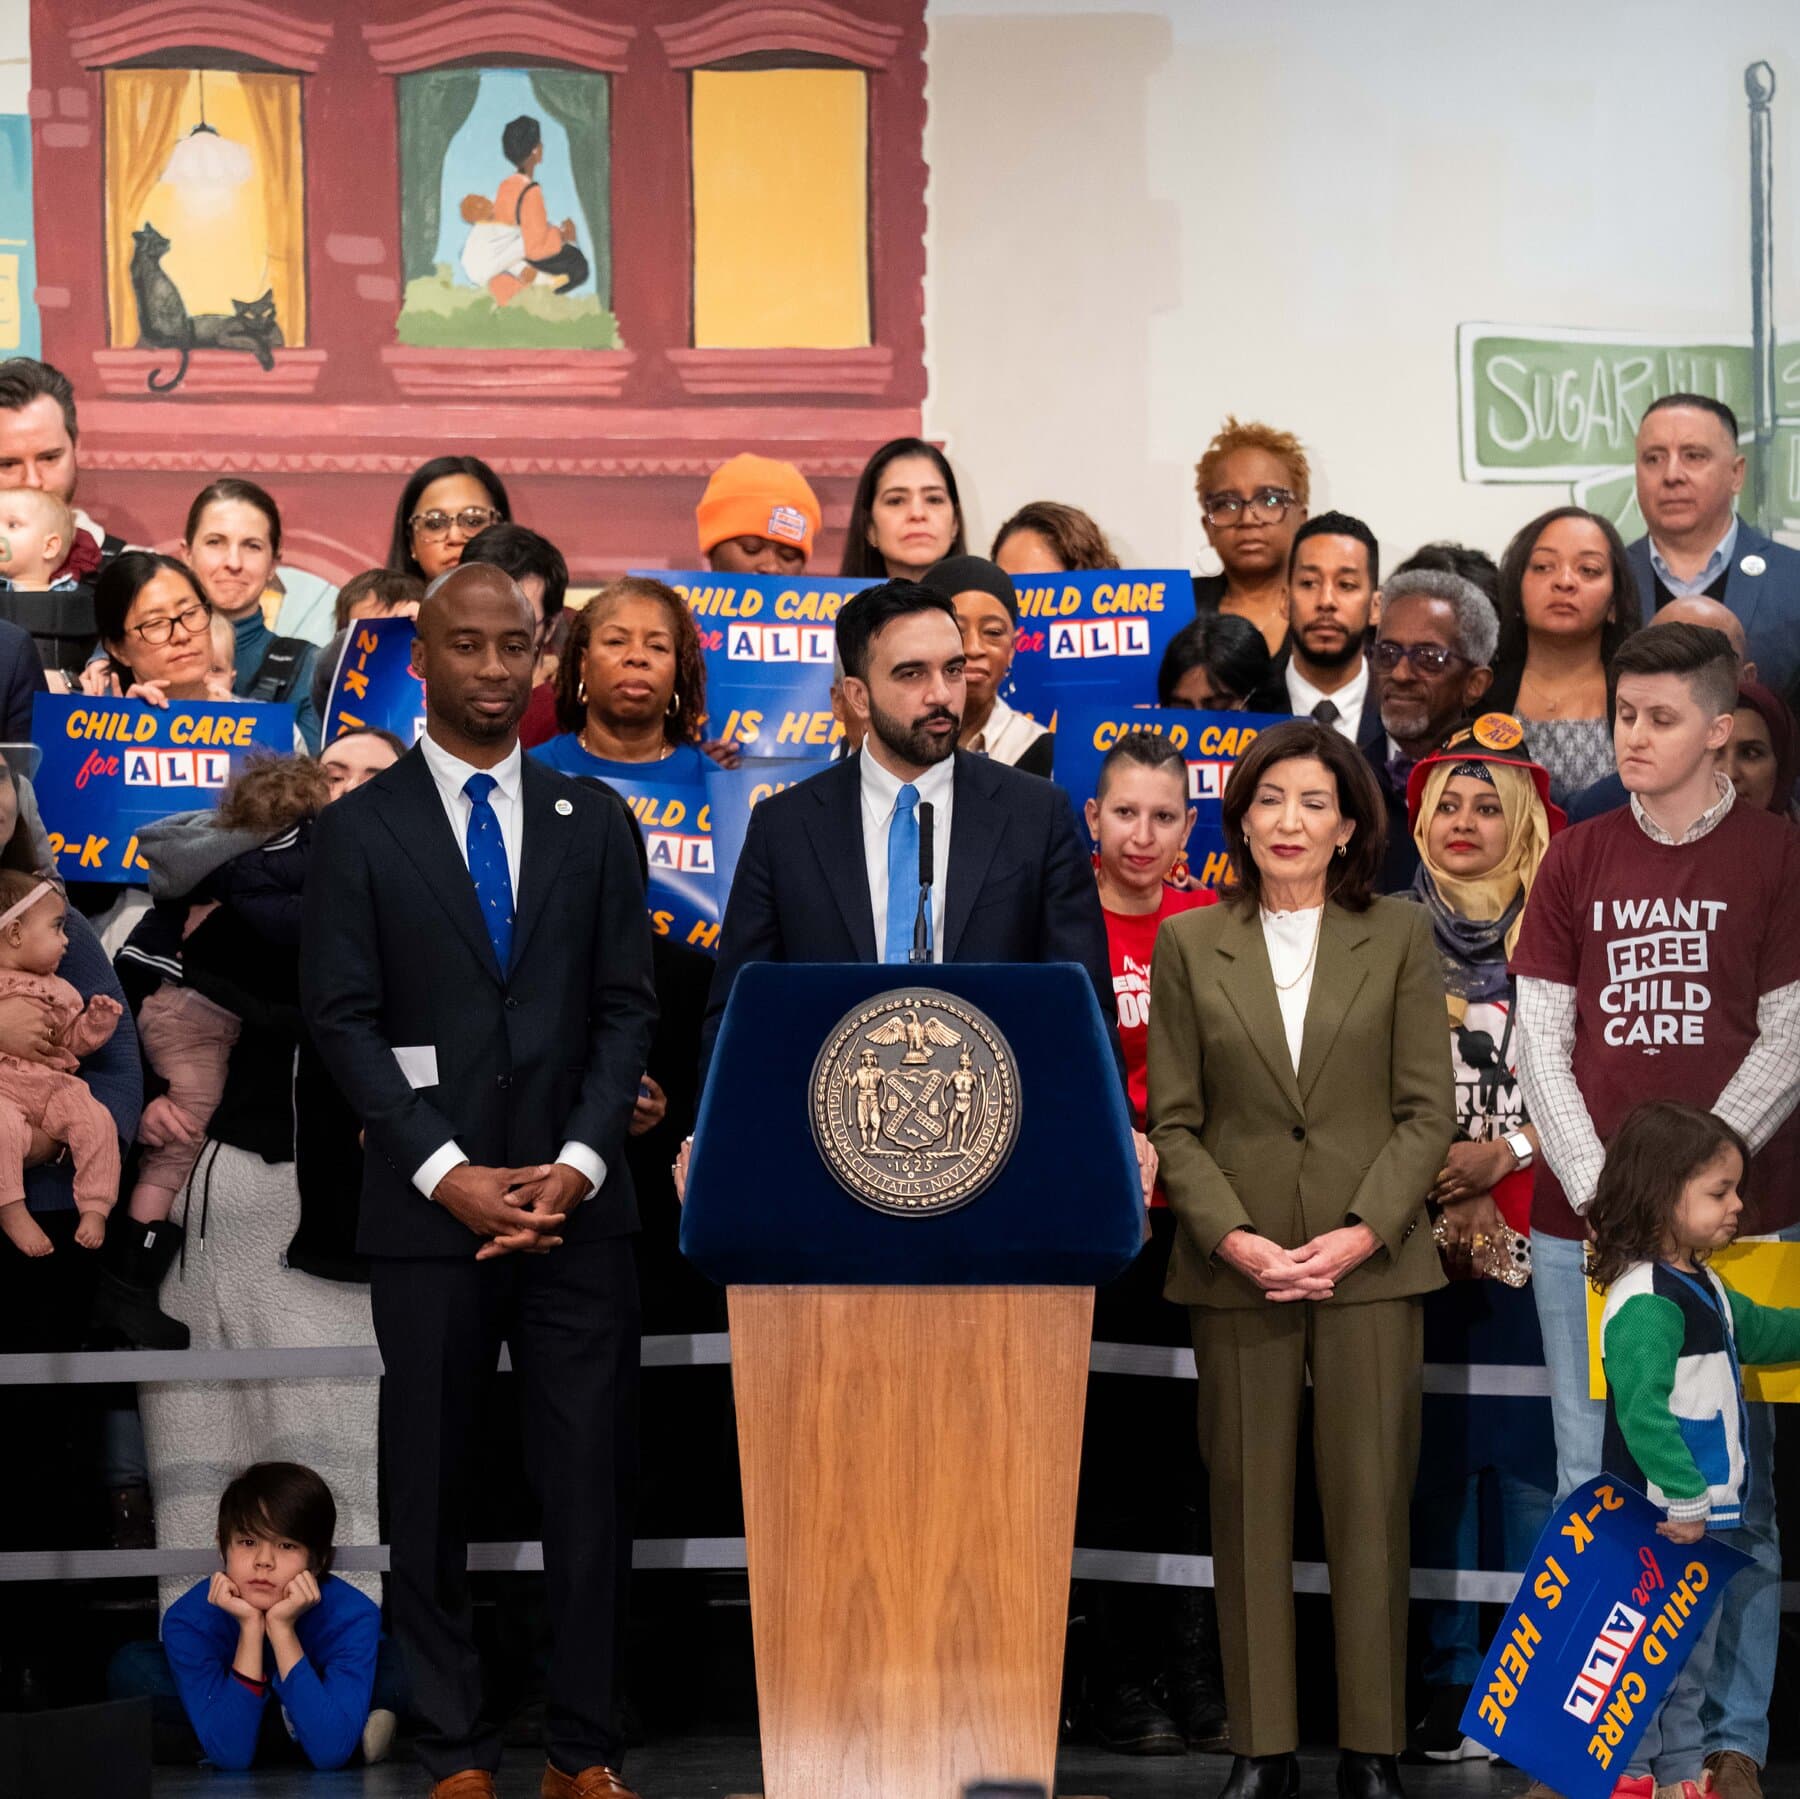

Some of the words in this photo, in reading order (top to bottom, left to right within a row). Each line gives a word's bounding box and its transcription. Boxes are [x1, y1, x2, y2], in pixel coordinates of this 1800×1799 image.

[1486, 354, 1651, 451] SUGAR
[1015, 585, 1082, 618] HILD
[1091, 582, 1166, 615] CARE
[699, 626, 723, 651] or
[732, 629, 829, 659] ALL
[1054, 626, 1145, 654] ALL
[344, 629, 379, 701] 2-K
[66, 709, 157, 743] CHILD
[169, 714, 257, 747] CARE
[721, 709, 764, 744] IS
[75, 749, 119, 790] for
[128, 753, 228, 785] ALL
[650, 839, 710, 869] AL
[1593, 901, 1603, 932] I
[1612, 897, 1728, 931] WANT
[1610, 936, 1703, 978] FREE
[1599, 979, 1712, 1015] CHILD
[1603, 1014, 1705, 1047] CARE
[1455, 1085, 1522, 1115] RUM
[829, 1080, 855, 1155] SIGILLUM
[850, 1157, 922, 1194] CIVITATIS
[930, 1161, 967, 1193] NOVI
[969, 1099, 1000, 1164] EBORACI
[893, 1160, 933, 1173] 1625
[1560, 1484, 1625, 1555] 2-K
[1533, 1555, 1571, 1611] IS
[1630, 1546, 1666, 1607] for
[1642, 1560, 1710, 1666] CHILD
[1477, 1612, 1543, 1738] HERE
[1567, 1605, 1638, 1711] ALL
[1586, 1671, 1647, 1771] CARE
